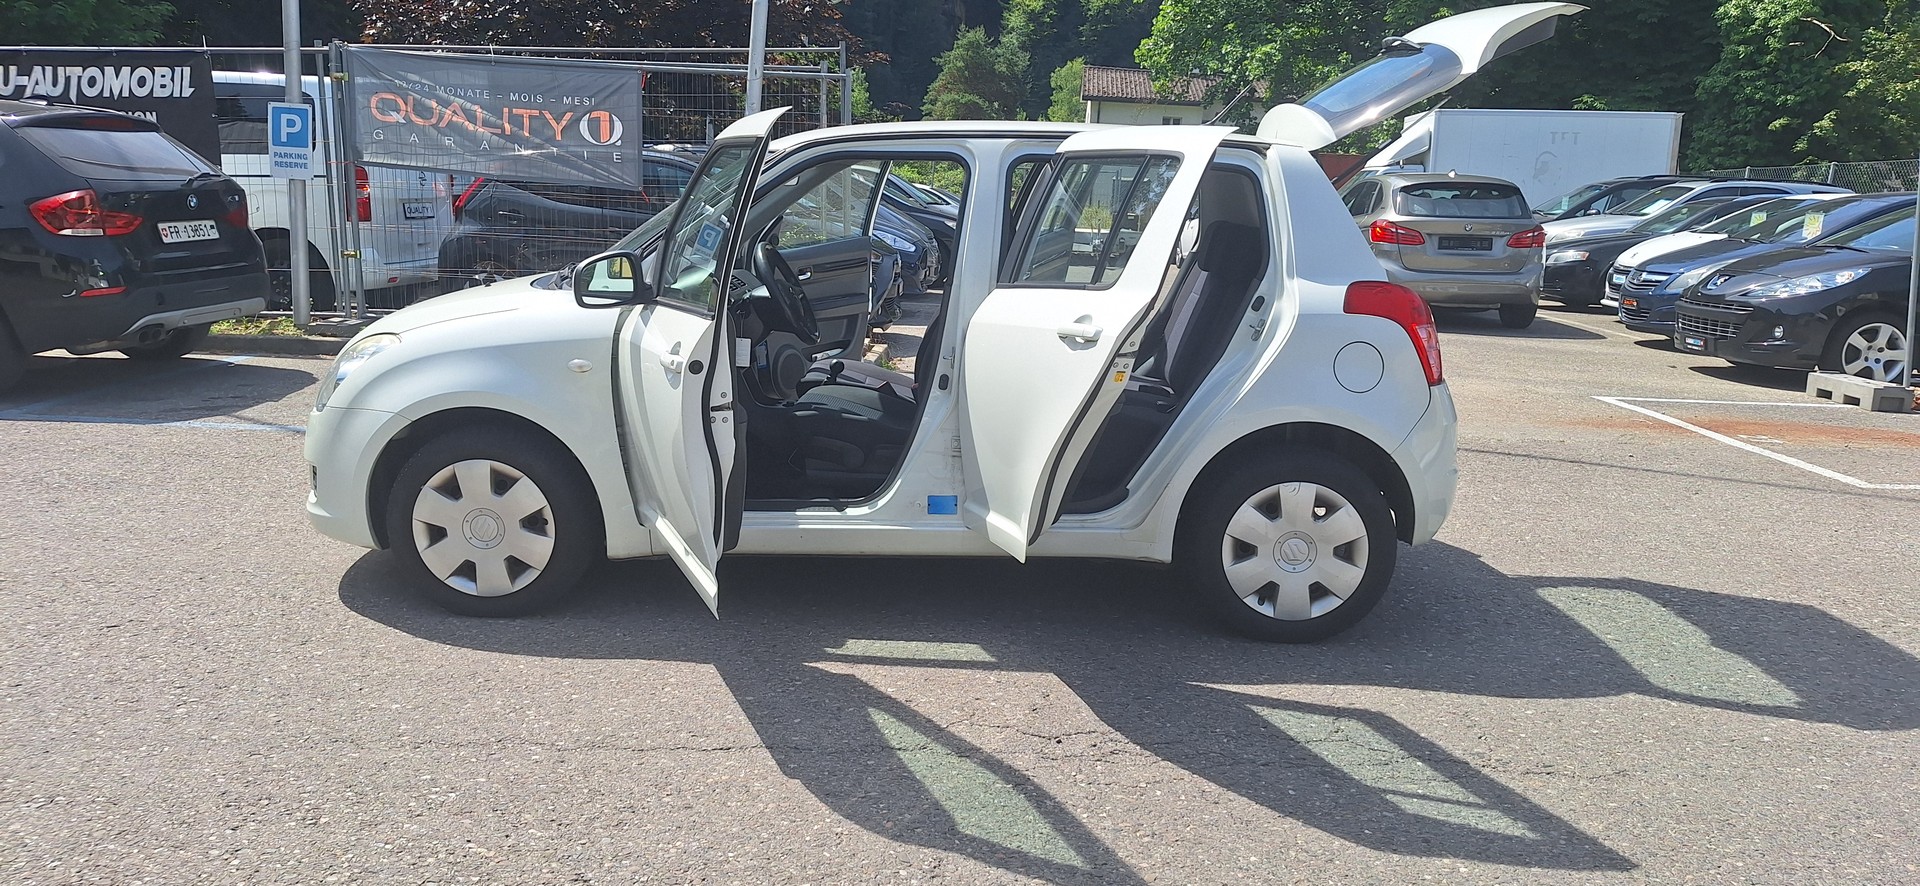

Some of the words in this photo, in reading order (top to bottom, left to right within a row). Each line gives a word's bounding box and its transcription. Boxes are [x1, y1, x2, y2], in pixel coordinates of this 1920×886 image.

[435, 85, 490, 98] MONATE
[510, 92, 543, 103] MOIS
[563, 96, 595, 106] MESI
[280, 113, 302, 142] P
[370, 92, 574, 141] QUALITY
[273, 151, 308, 160] PARKING
[373, 129, 622, 163] GARANTIE
[274, 161, 309, 169] RESERVE
